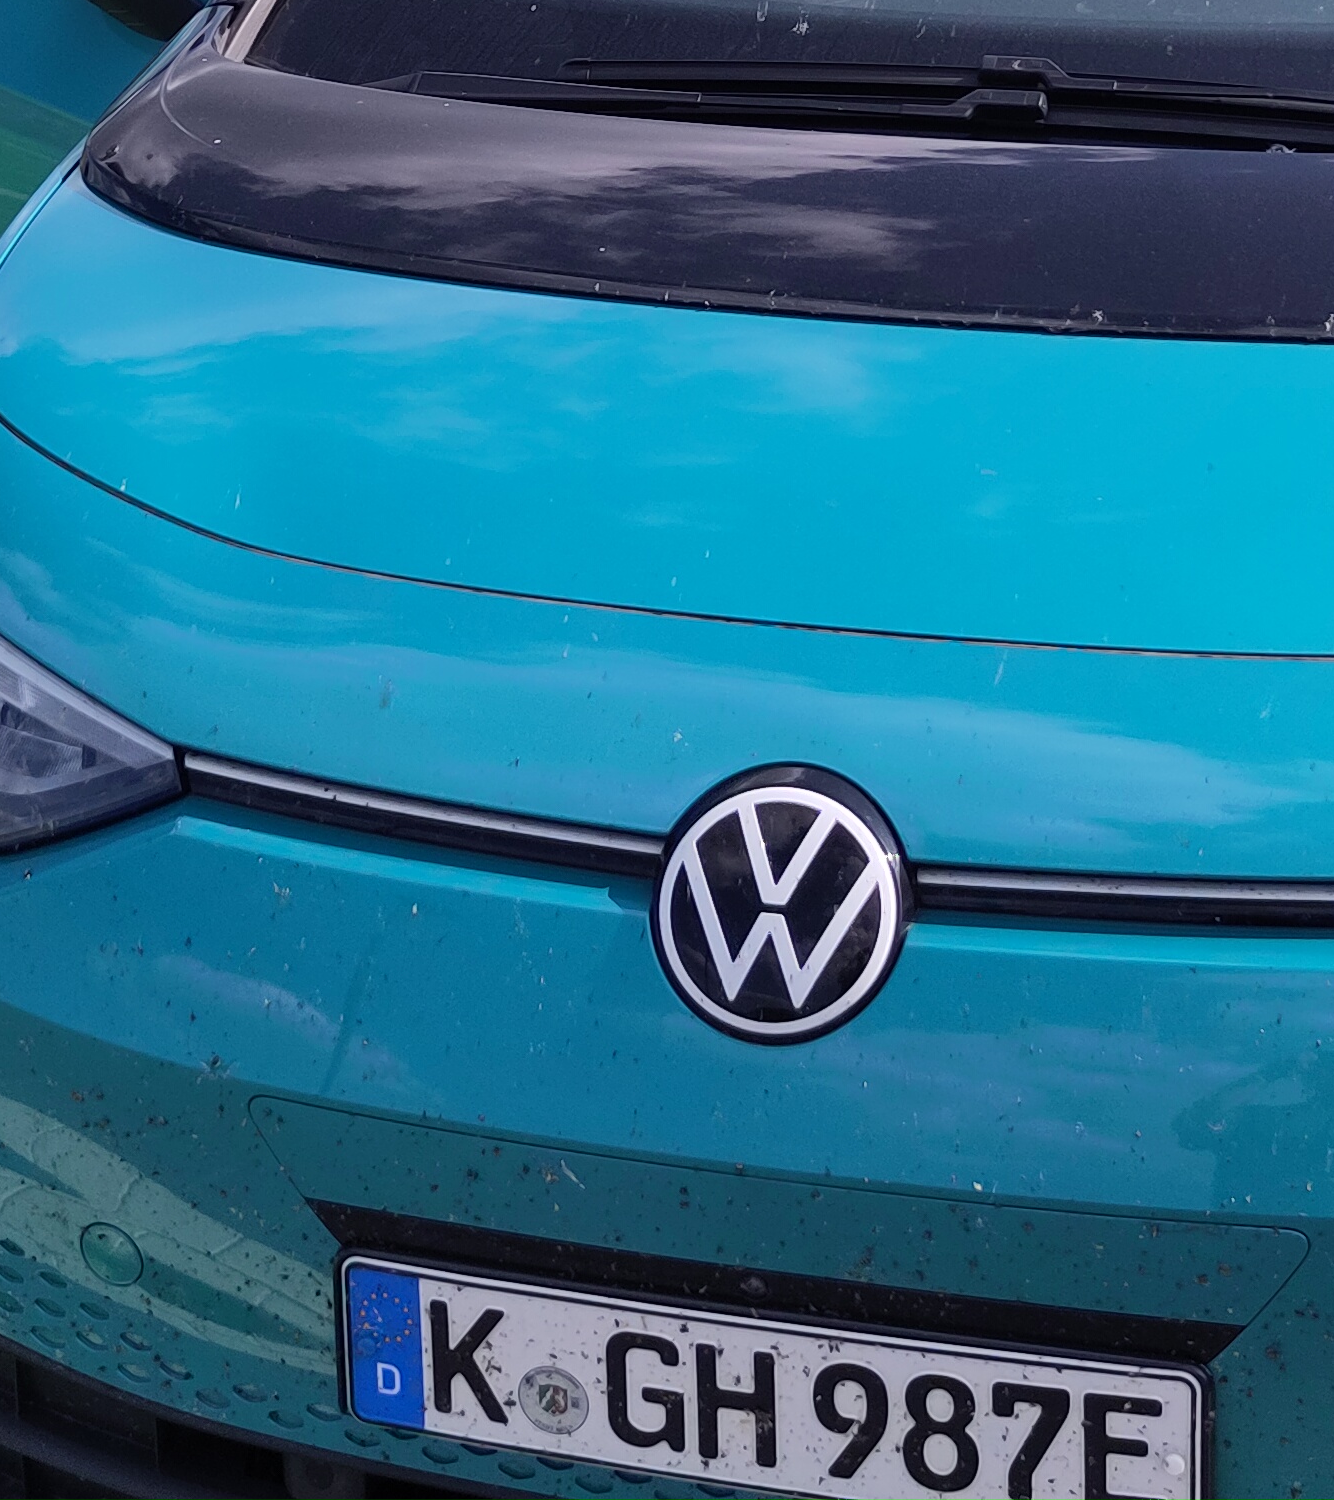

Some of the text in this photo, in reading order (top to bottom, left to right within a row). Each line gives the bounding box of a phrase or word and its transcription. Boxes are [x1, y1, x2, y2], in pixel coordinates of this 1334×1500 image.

[375, 1361, 402, 1396] D
[428, 1298, 509, 1425] K
[605, 1330, 776, 1468] GH
